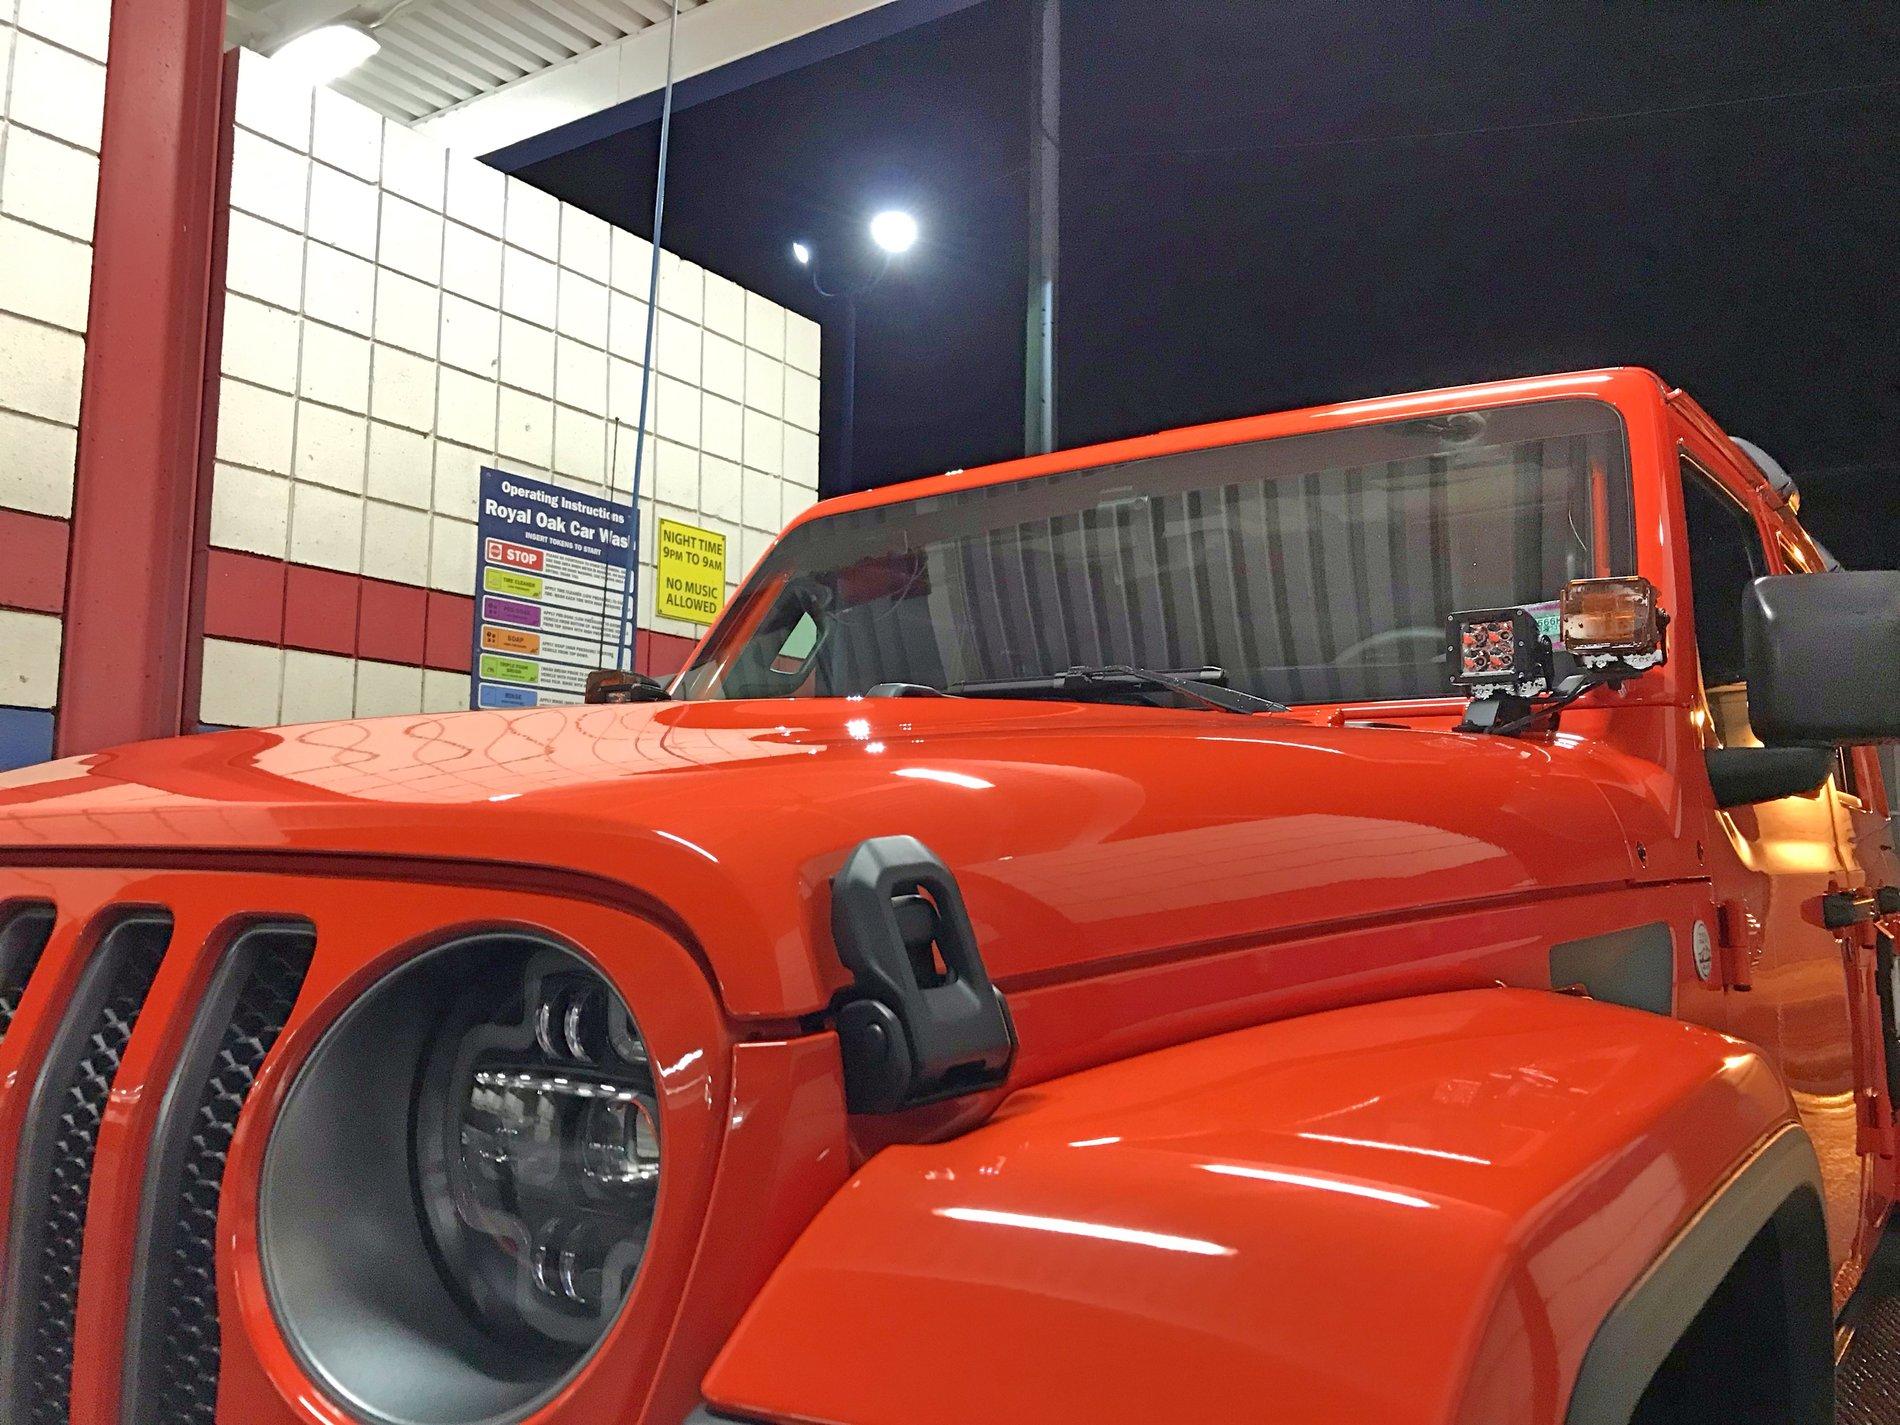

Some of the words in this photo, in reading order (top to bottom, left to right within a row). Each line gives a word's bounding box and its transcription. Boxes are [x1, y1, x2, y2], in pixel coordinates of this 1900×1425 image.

[501, 481, 559, 508] Operating
[485, 498, 532, 524] Royal
[535, 511, 566, 534] Oak
[570, 521, 595, 540] Car
[599, 527, 636, 551] Was
[525, 531, 548, 544] INSERT
[549, 536, 574, 550] TOKENS
[574, 543, 583, 552] TO
[583, 545, 602, 556] START
[663, 529, 697, 548] NIGHT
[698, 539, 723, 556] TIME
[506, 549, 538, 565] STOP
[663, 546, 683, 561] 9PM
[686, 551, 700, 566] TO
[702, 556, 722, 571] 9AM
[666, 577, 682, 591] NO
[685, 581, 718, 599] MUSIC
[666, 593, 717, 614] ALLOWED
